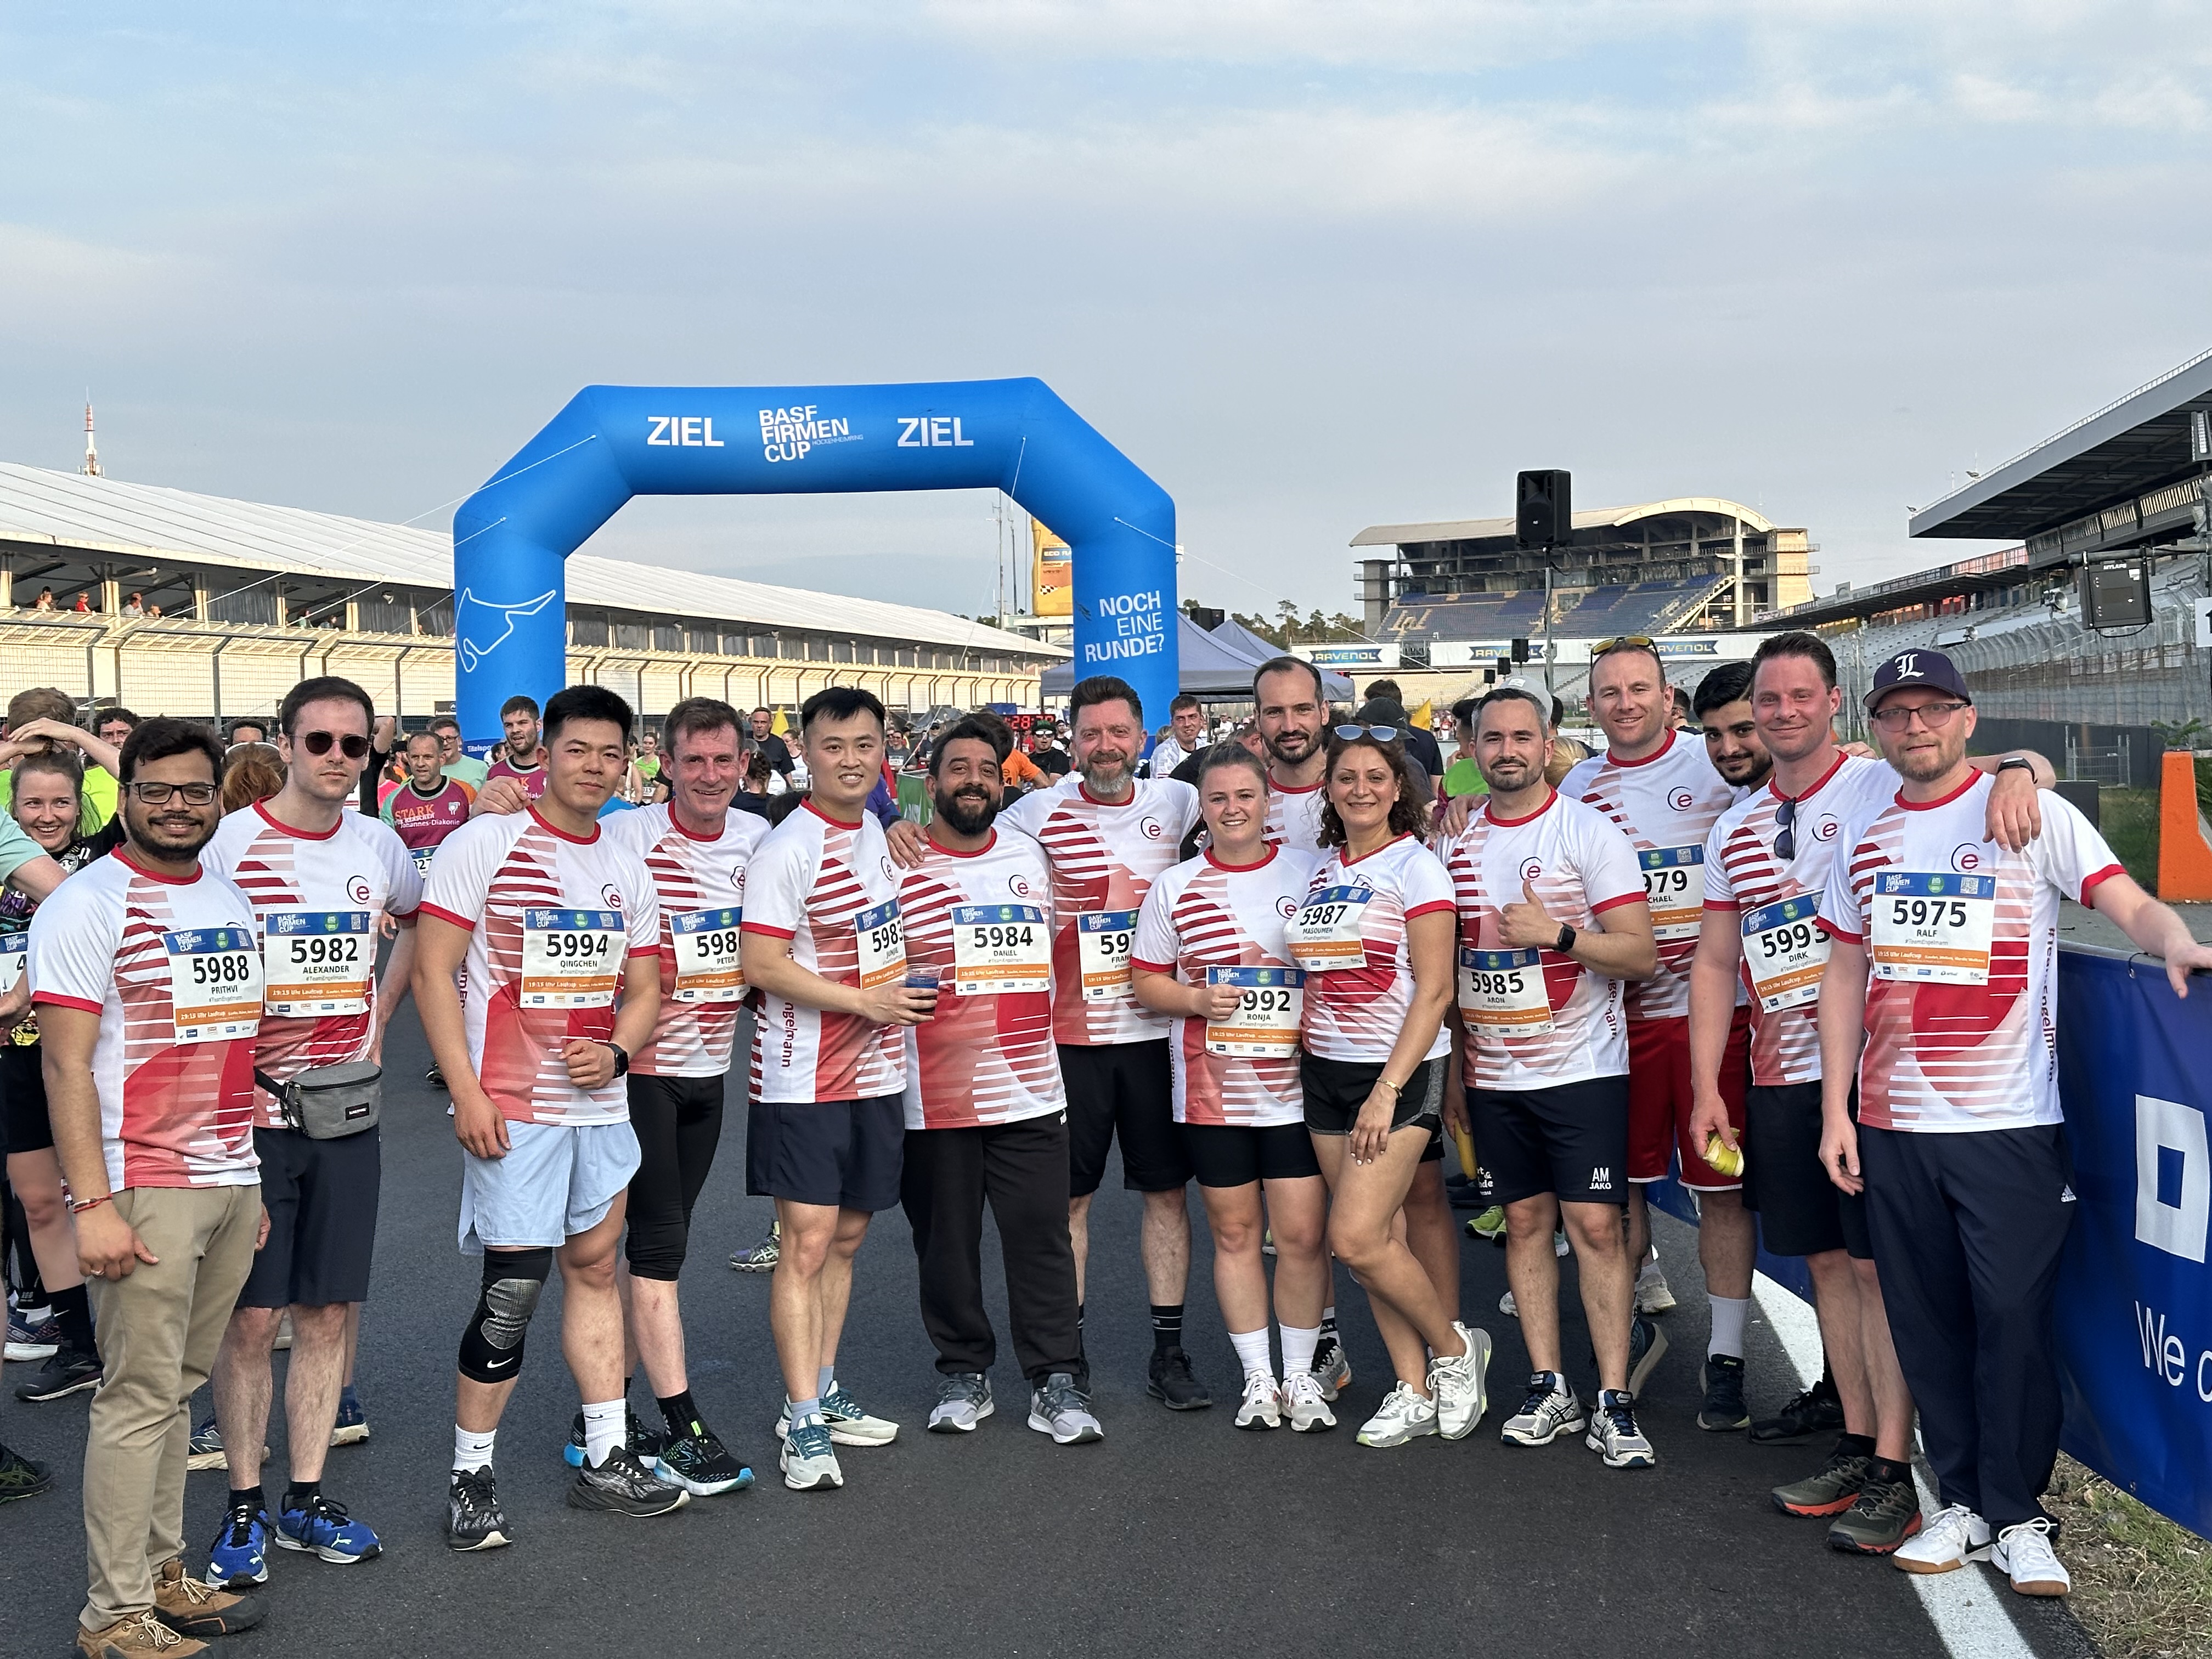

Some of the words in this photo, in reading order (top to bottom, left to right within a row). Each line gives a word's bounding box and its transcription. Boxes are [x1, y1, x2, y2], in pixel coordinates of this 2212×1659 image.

[759, 405, 817, 426] BASF
[647, 416, 724, 447] ZIEL
[761, 417, 849, 444] FIRMEN
[898, 417, 974, 447] ZIEL
[765, 441, 810, 462] CUP
[1099, 590, 1161, 617] NOCH
[1117, 612, 1163, 636] EINE
[1085, 634, 1164, 662] RUNDE?
[1315, 651, 1376, 661] RAVENOL
[1475, 649, 1538, 658] RAVEL
[1895, 654, 1924, 680] L
[395, 804, 434, 819] STARK
[1300, 905, 1348, 926] 5987
[1893, 900, 1966, 927] 5975
[546, 934, 608, 957] 5994
[696, 931, 741, 957] 598
[872, 919, 903, 952] 5983
[974, 926, 1033, 948] 5984
[1101, 931, 1136, 955] 59
[291, 938, 358, 963] 5982
[1789, 951, 1808, 962] DIRK
[193, 955, 249, 984] 5988
[303, 966, 349, 974] ALEXANDER
[211, 985, 238, 994] PRITHVI
[1471, 971, 1524, 995] 5985
[1235, 990, 1290, 1012] 992
[1592, 1167, 1609, 1182] AM
[2135, 1300, 2185, 1387] We
